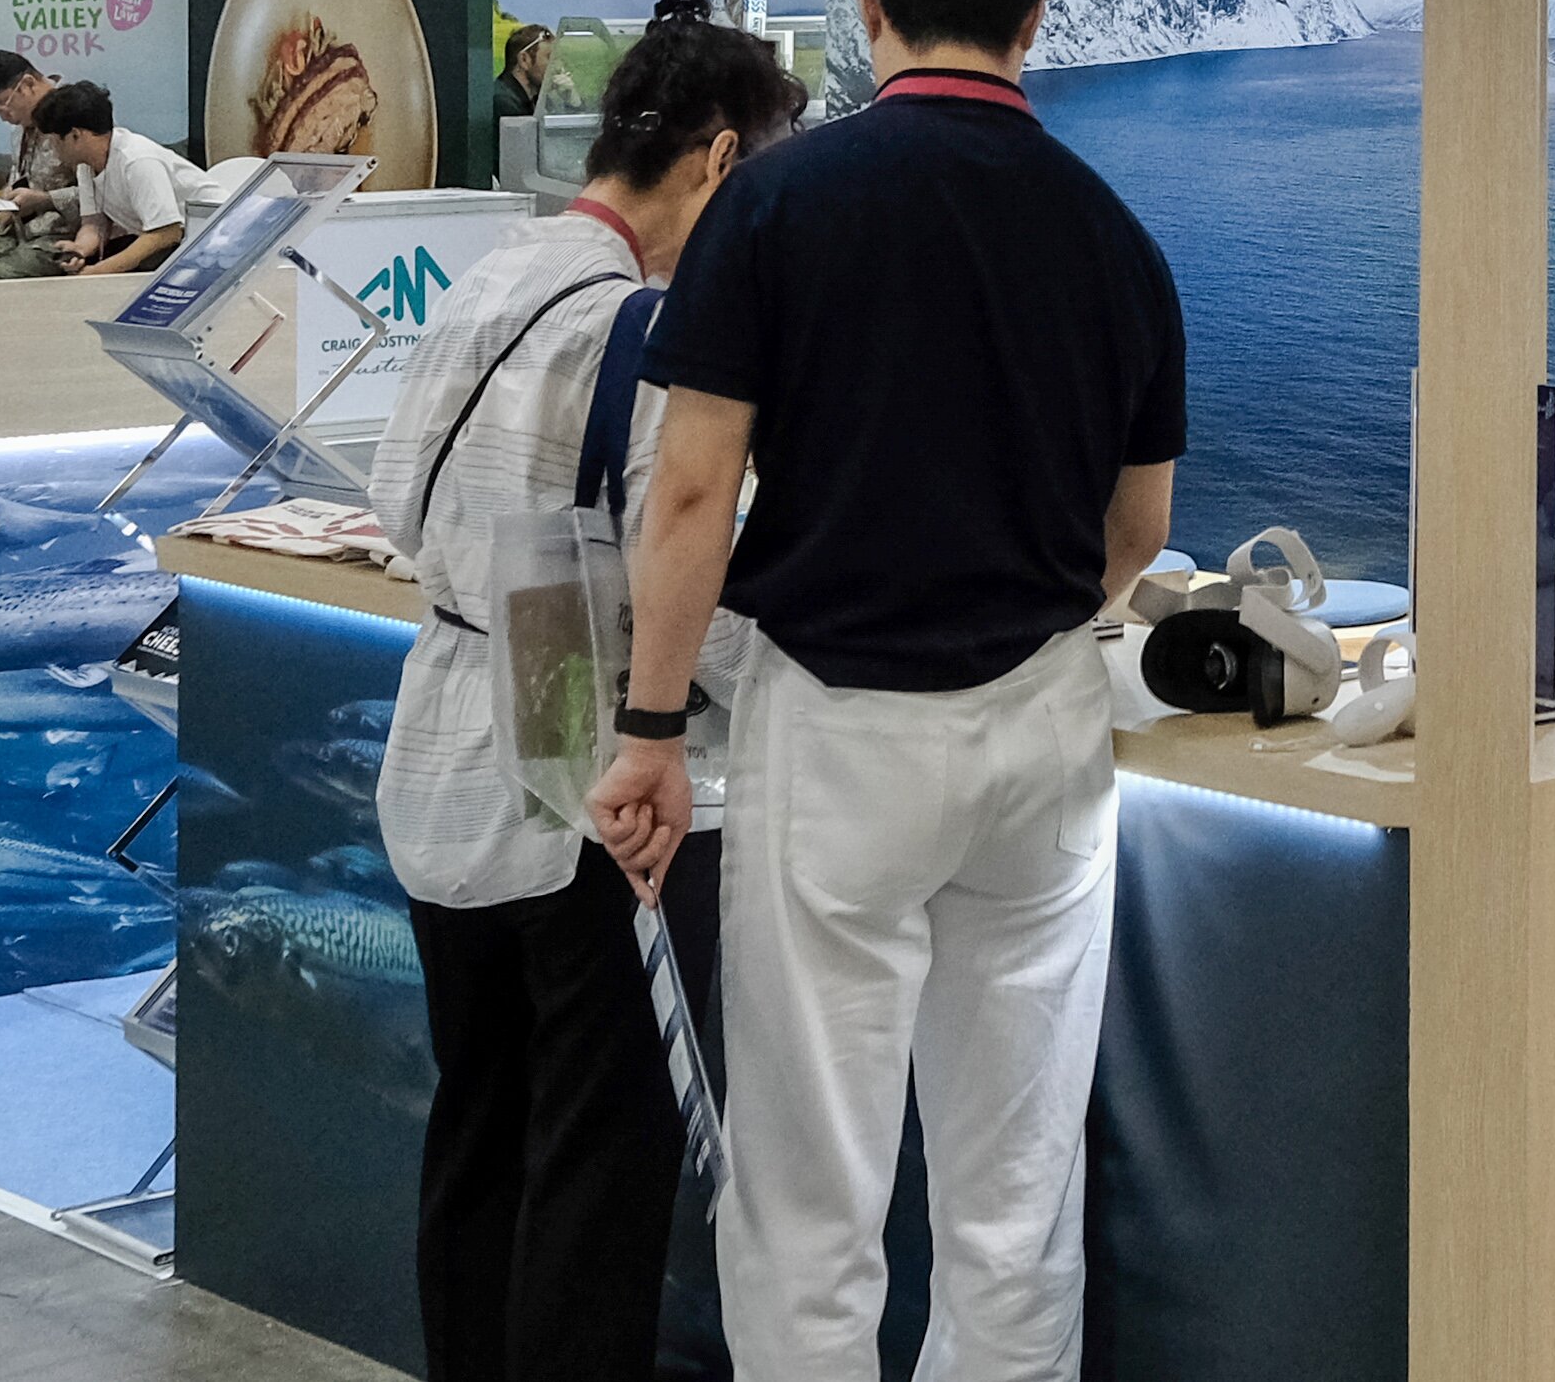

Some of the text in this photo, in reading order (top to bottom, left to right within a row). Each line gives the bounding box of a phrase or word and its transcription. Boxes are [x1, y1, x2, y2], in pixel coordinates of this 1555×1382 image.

[13, 7, 103, 31] VALLEY
[15, 31, 105, 57] PORK
[322, 338, 361, 353] CRAIG
